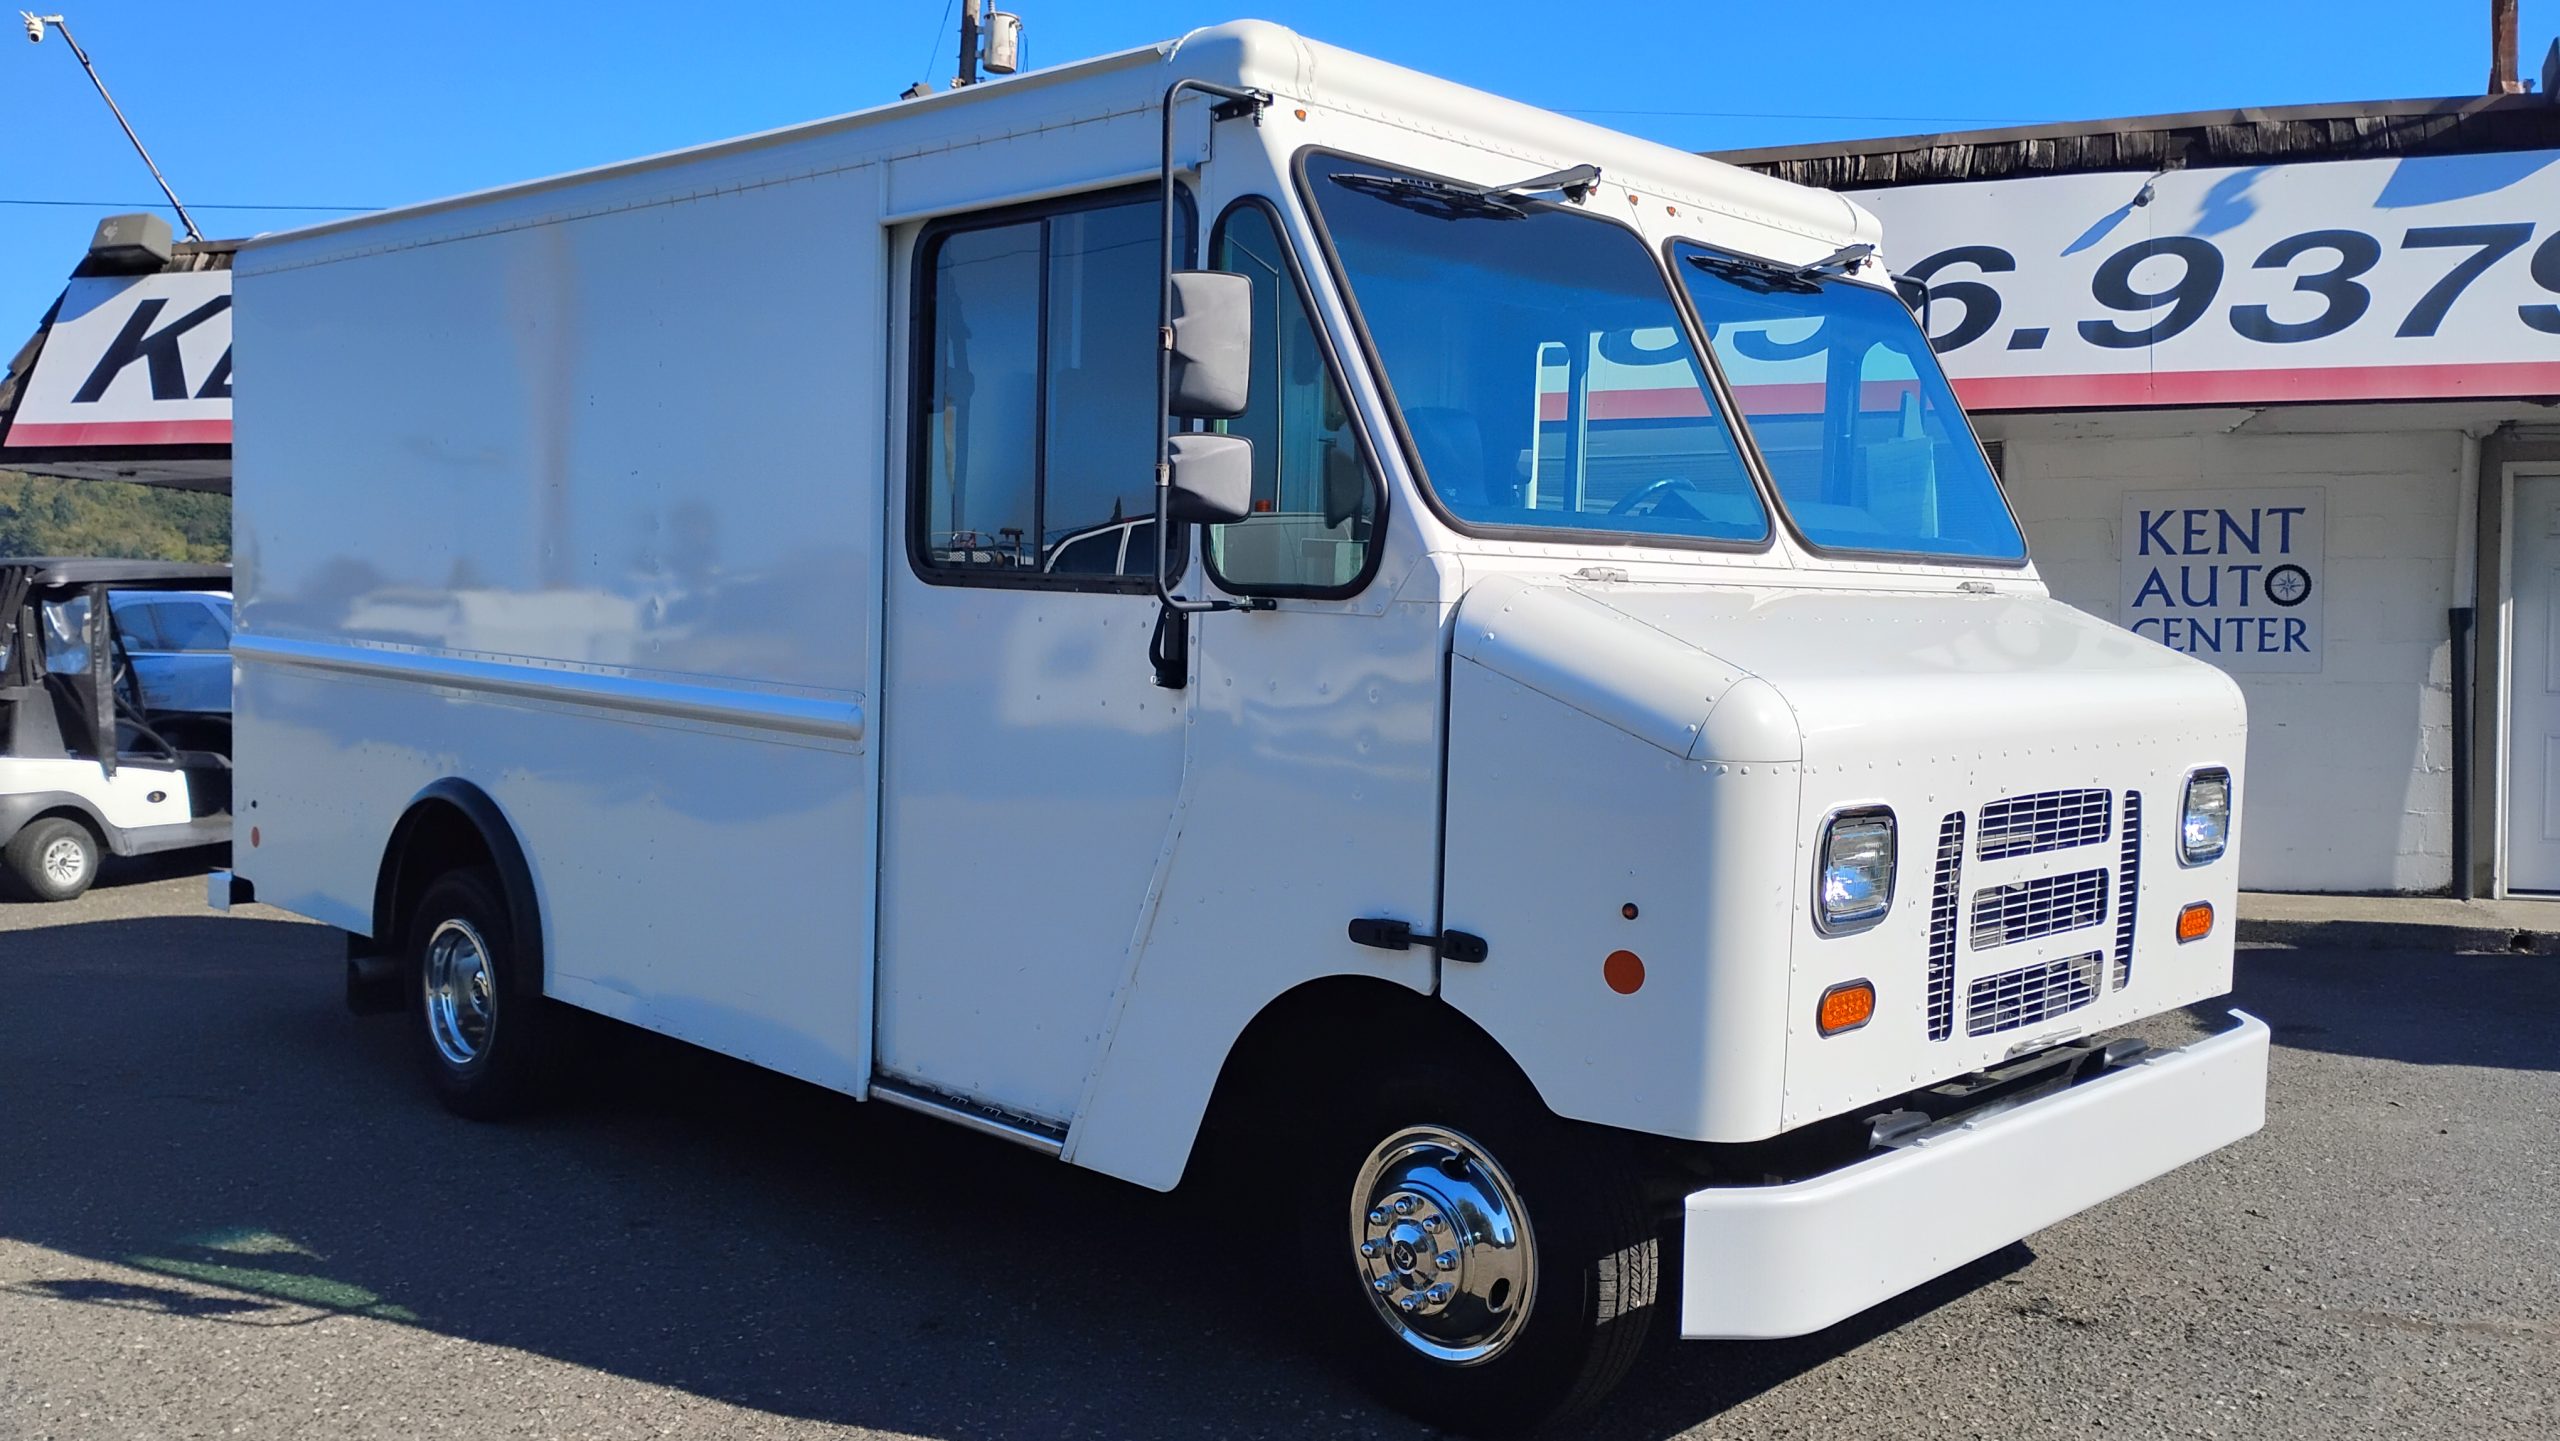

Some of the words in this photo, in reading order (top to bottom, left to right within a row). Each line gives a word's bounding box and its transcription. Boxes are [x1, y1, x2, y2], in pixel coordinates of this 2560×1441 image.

[70, 295, 232, 403] K
[2138, 507, 2306, 555] KENT
[2131, 563, 2312, 607] AUTO
